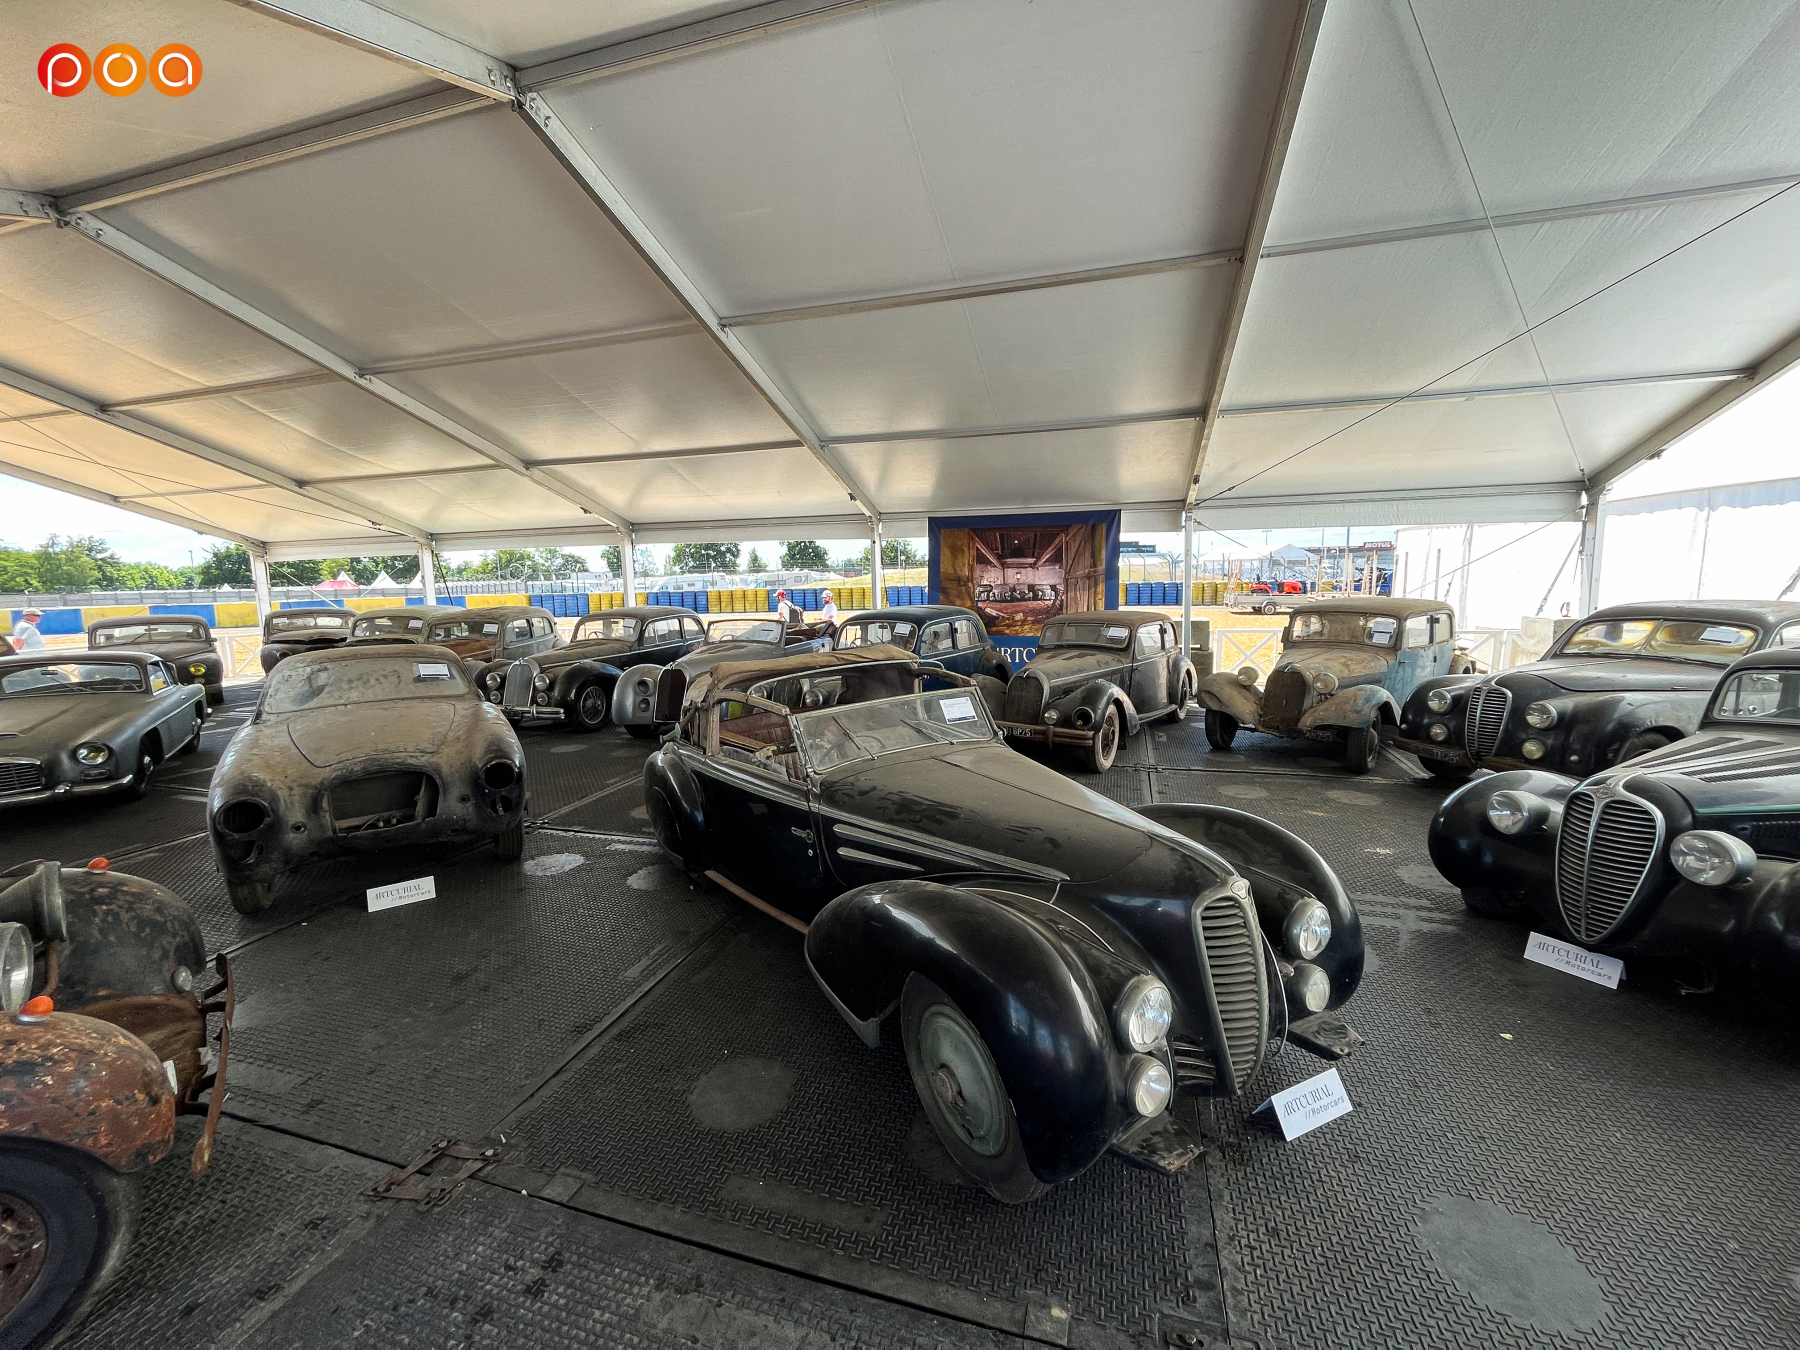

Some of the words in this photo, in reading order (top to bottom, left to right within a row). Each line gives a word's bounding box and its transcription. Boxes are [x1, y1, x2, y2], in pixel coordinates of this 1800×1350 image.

[997, 647, 1038, 663] RTC
[373, 883, 424, 900] ARTCURIAL
[1533, 941, 1603, 970] ARTCURIAL
[1283, 1084, 1334, 1118] ARTCURIAL
